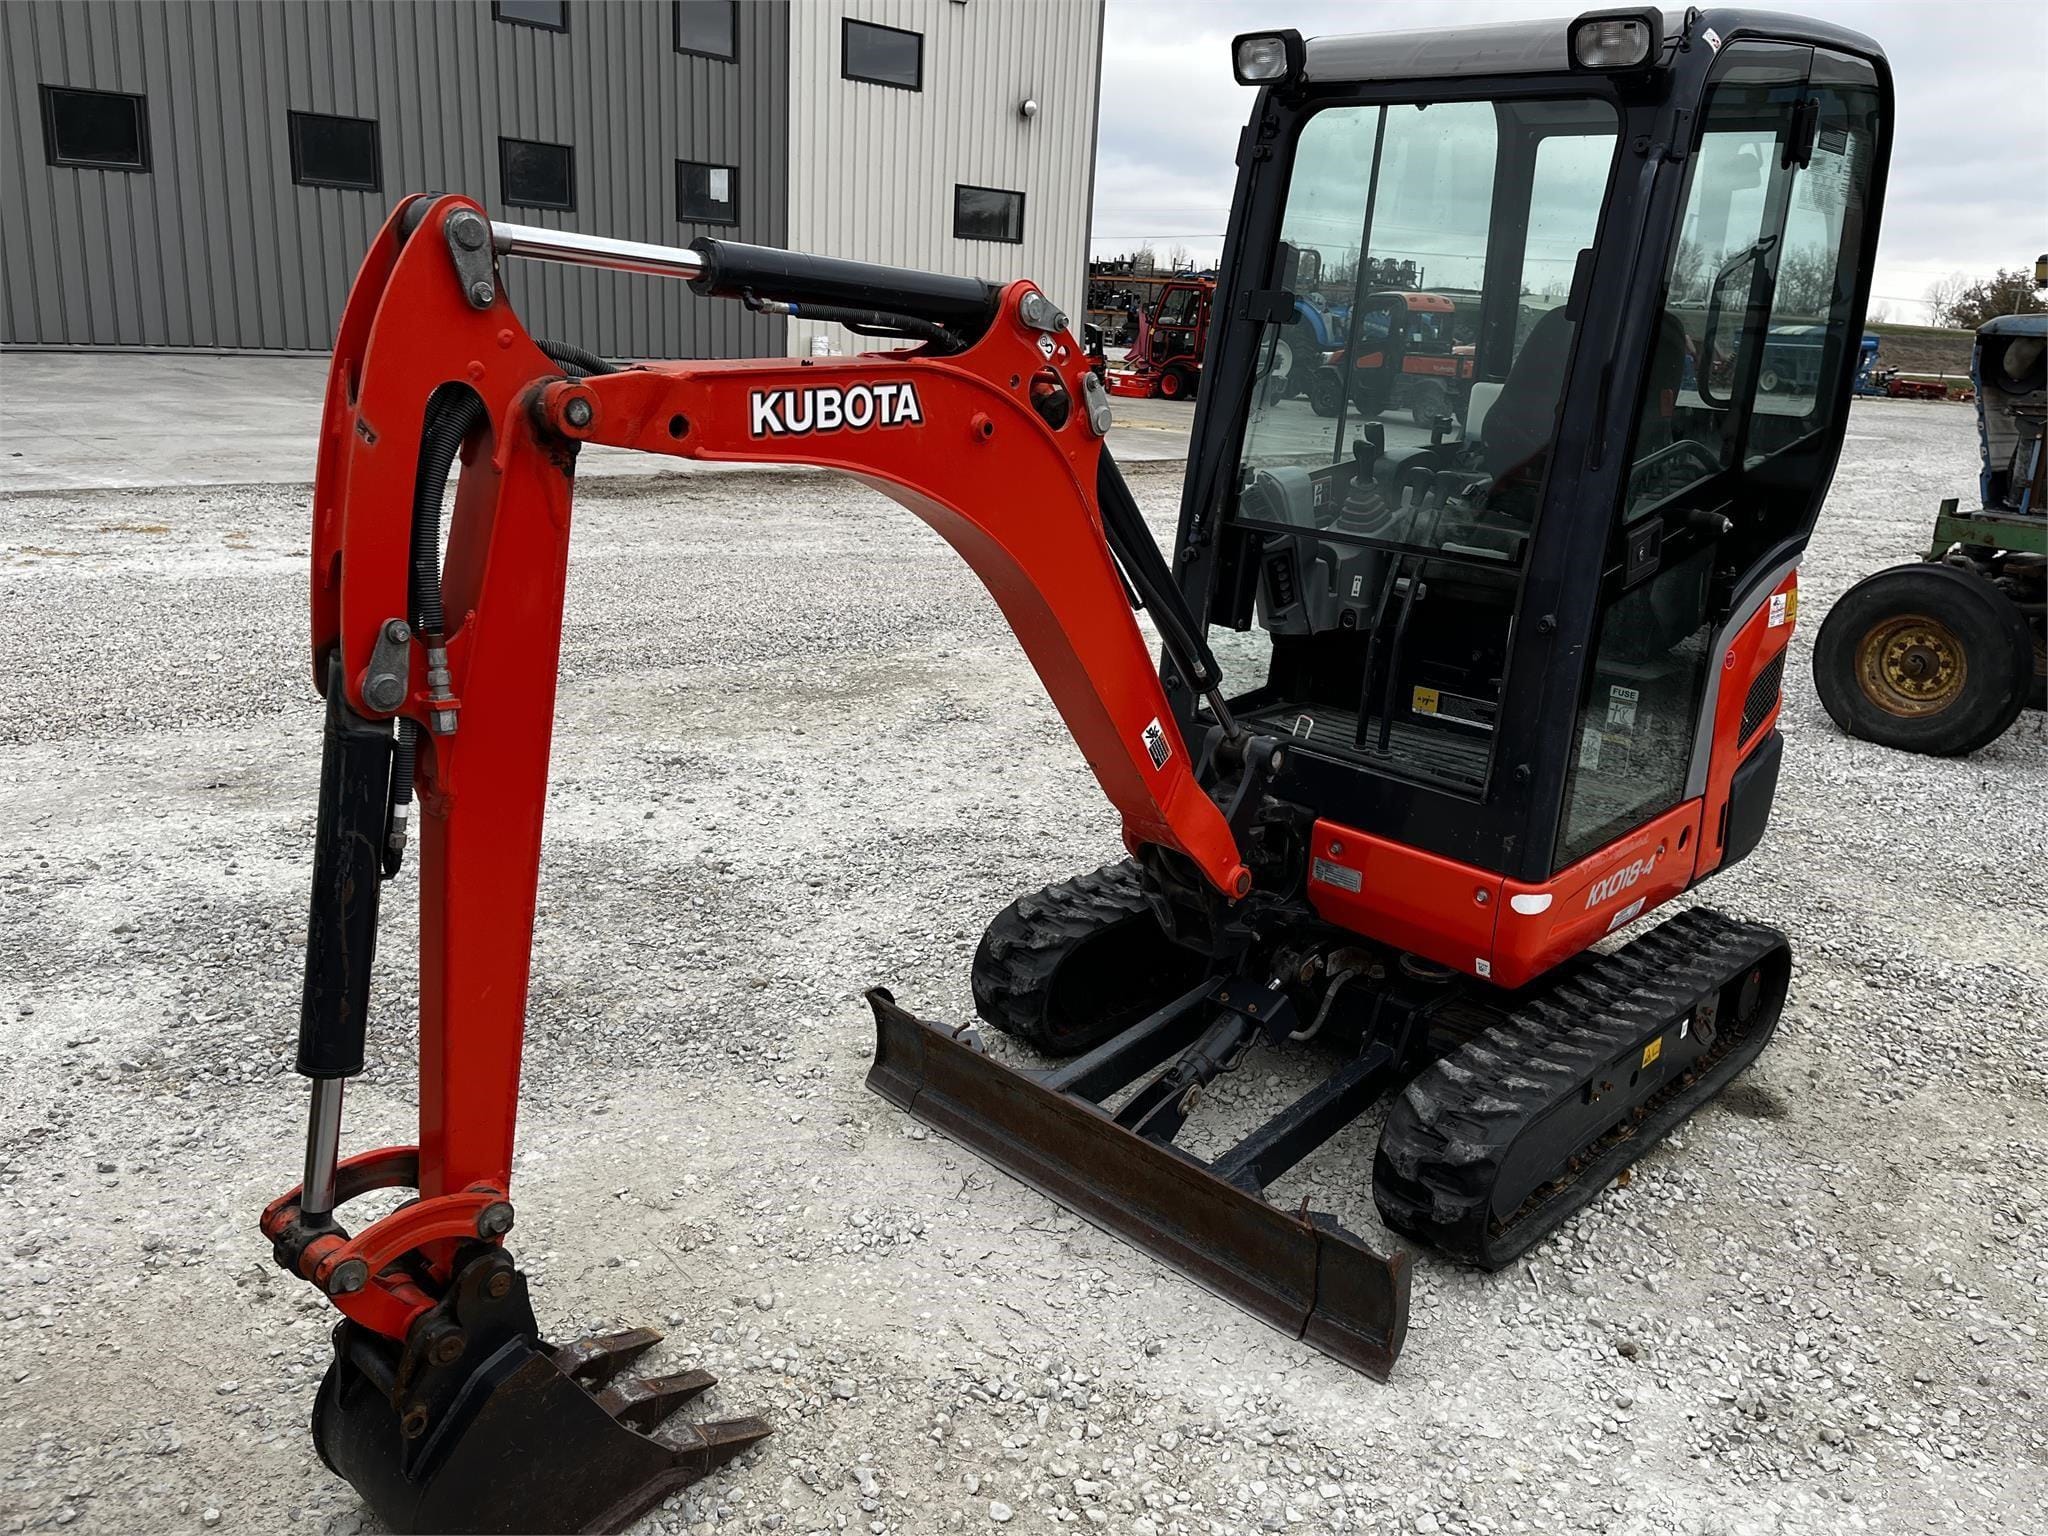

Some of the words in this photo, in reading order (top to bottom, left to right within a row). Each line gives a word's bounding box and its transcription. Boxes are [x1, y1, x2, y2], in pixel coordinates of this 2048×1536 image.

[751, 382, 922, 436] KUBOTA
[1612, 687, 1637, 699] FUSE
[1584, 854, 1656, 910] KX018-4
